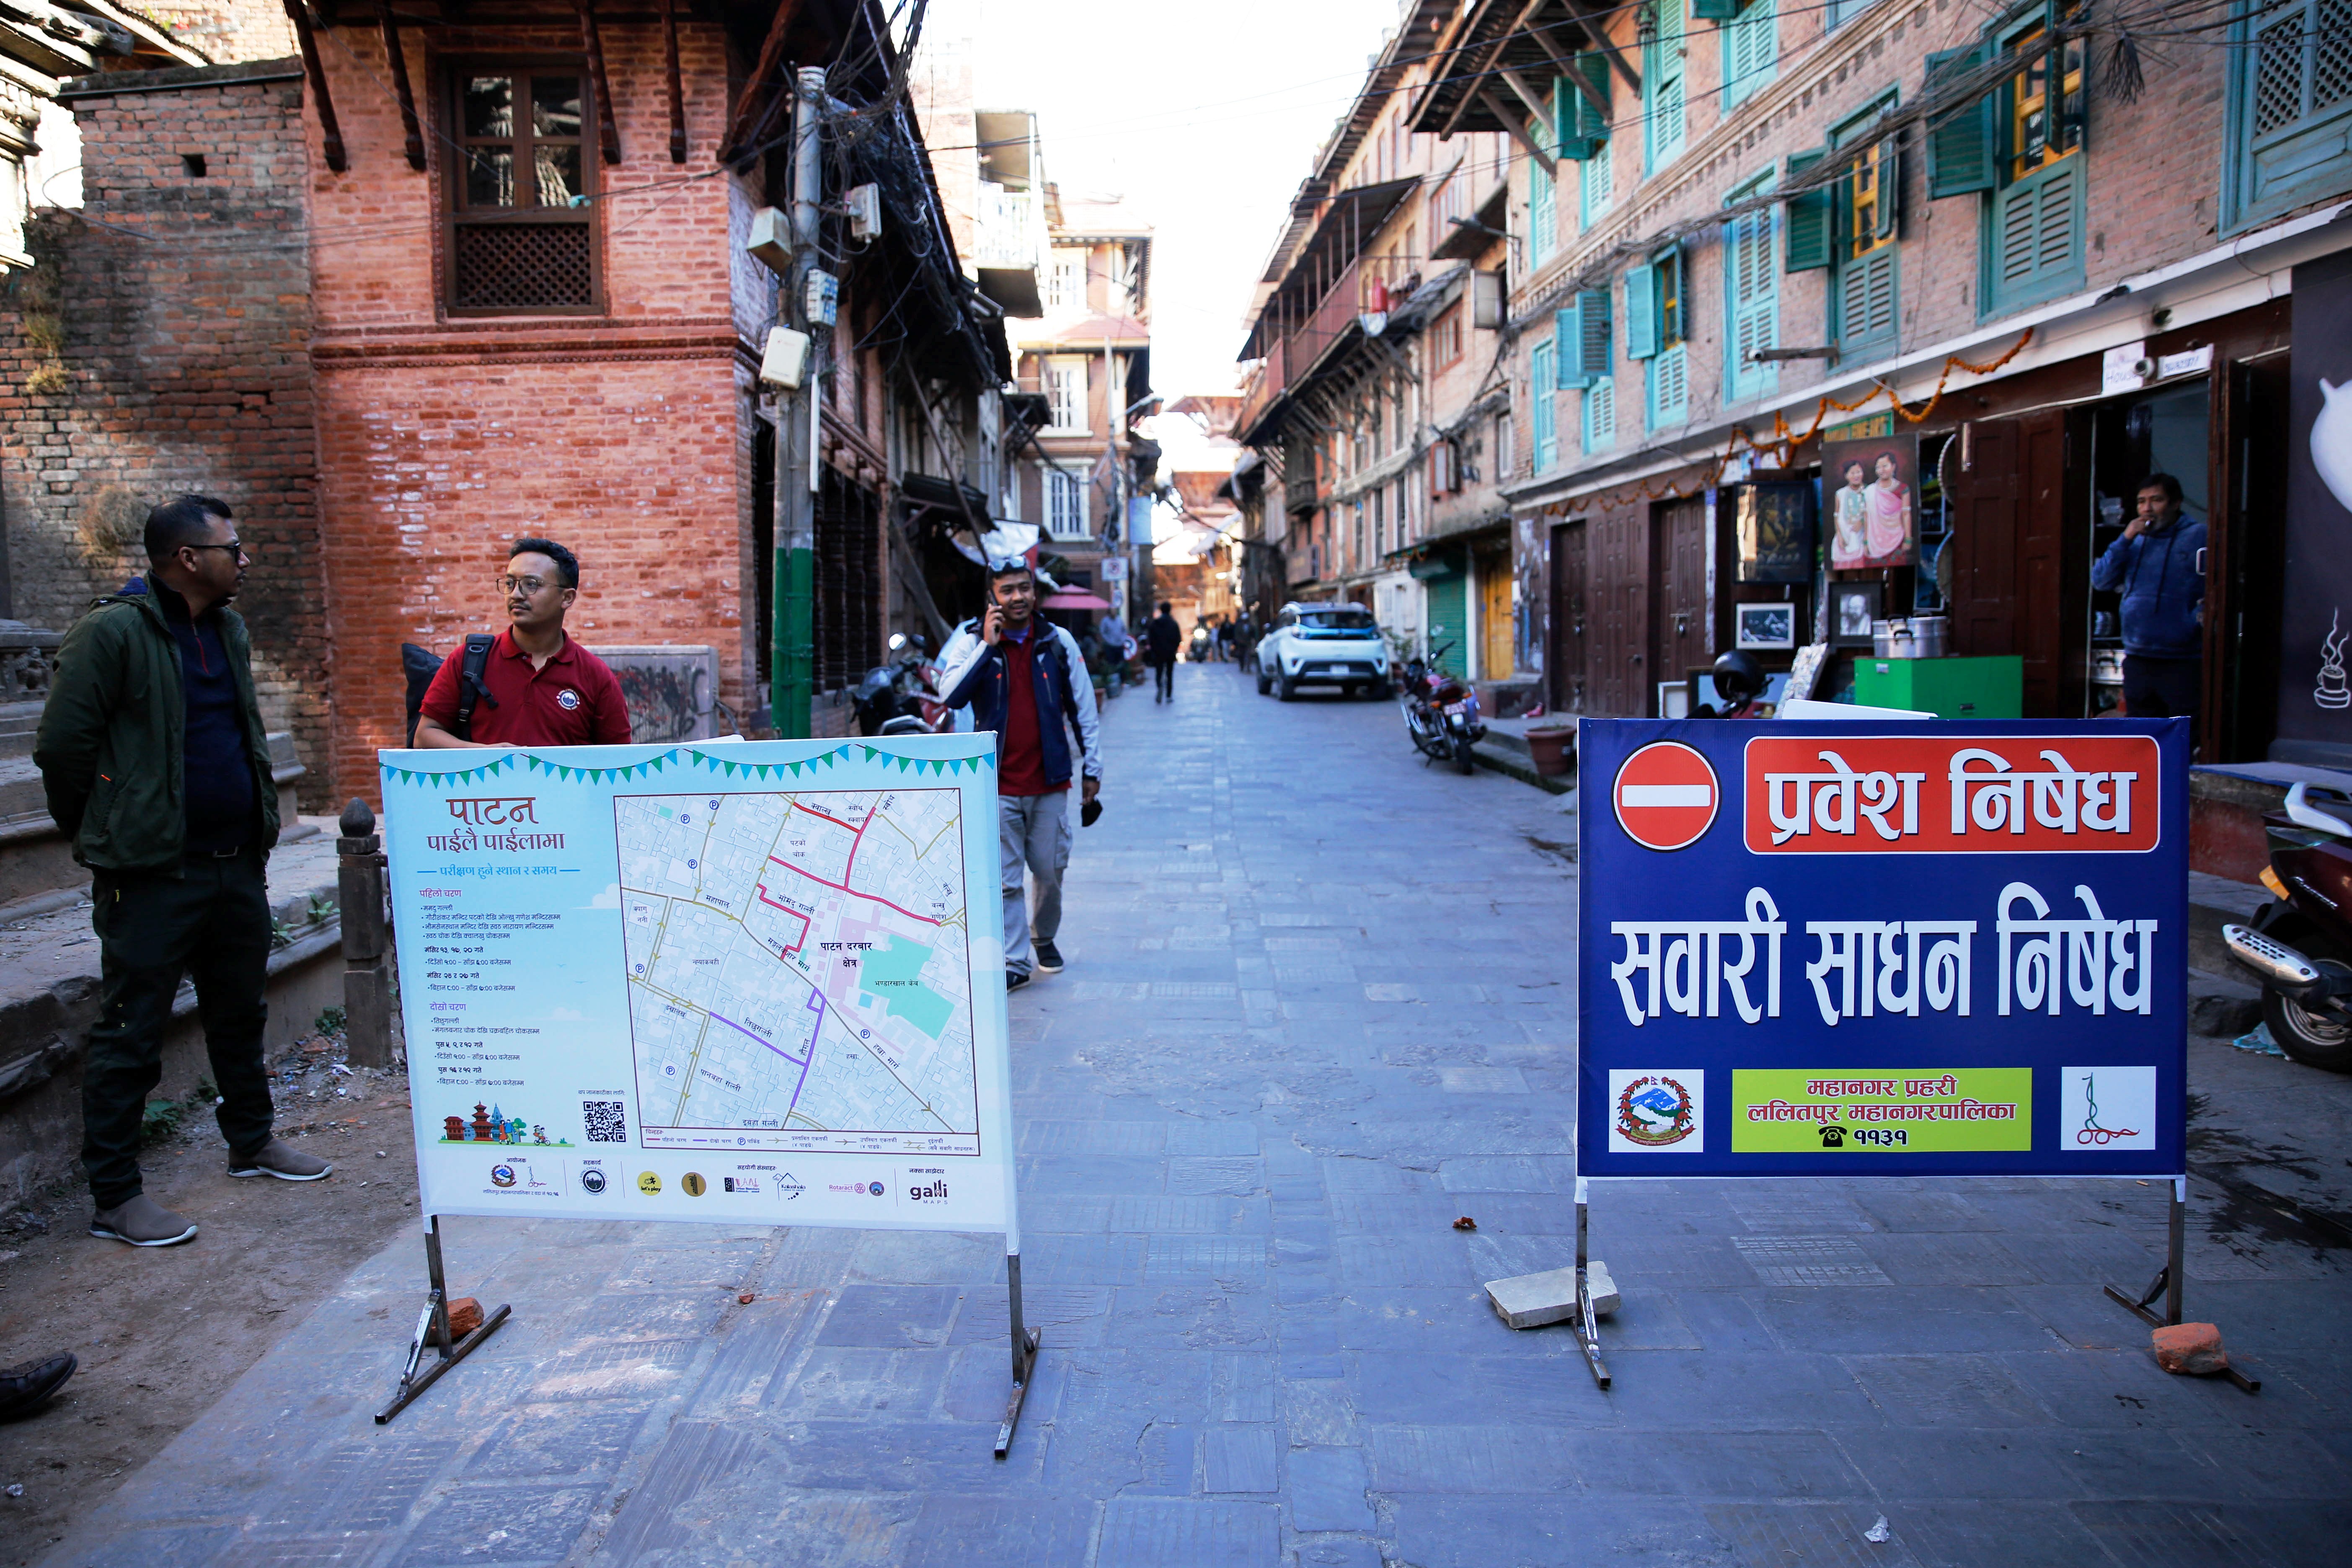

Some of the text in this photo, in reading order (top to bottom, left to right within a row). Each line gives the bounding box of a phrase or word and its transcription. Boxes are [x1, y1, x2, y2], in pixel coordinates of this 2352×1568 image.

[1764, 748, 2137, 846] प्रवेश निषेध
[446, 797, 539, 825] पाटन
[426, 827, 565, 853] पाईलै पाईलामा
[440, 864, 475, 877] परीक्षण
[478, 863, 493, 879] हुने
[496, 867, 521, 875] स्थान
[532, 866, 556, 875] समय
[420, 888, 442, 898] पहिलो
[706, 895, 730, 908] महापाल
[799, 902, 815, 915] गल्ली
[821, 942, 872, 951] पाटन दरबार
[1610, 881, 2158, 1027] सवारी साधन निषेध
[843, 957, 857, 967] क्षेत्र
[429, 1002, 447, 1011] दोस्रो
[1807, 1074, 1958, 1097] महानगर प्रहरी
[1747, 1098, 2017, 1124] ललितपुर महानगरपालिका
[1853, 1129, 1907, 1147] ११३१
[910, 1179, 947, 1200] galli
